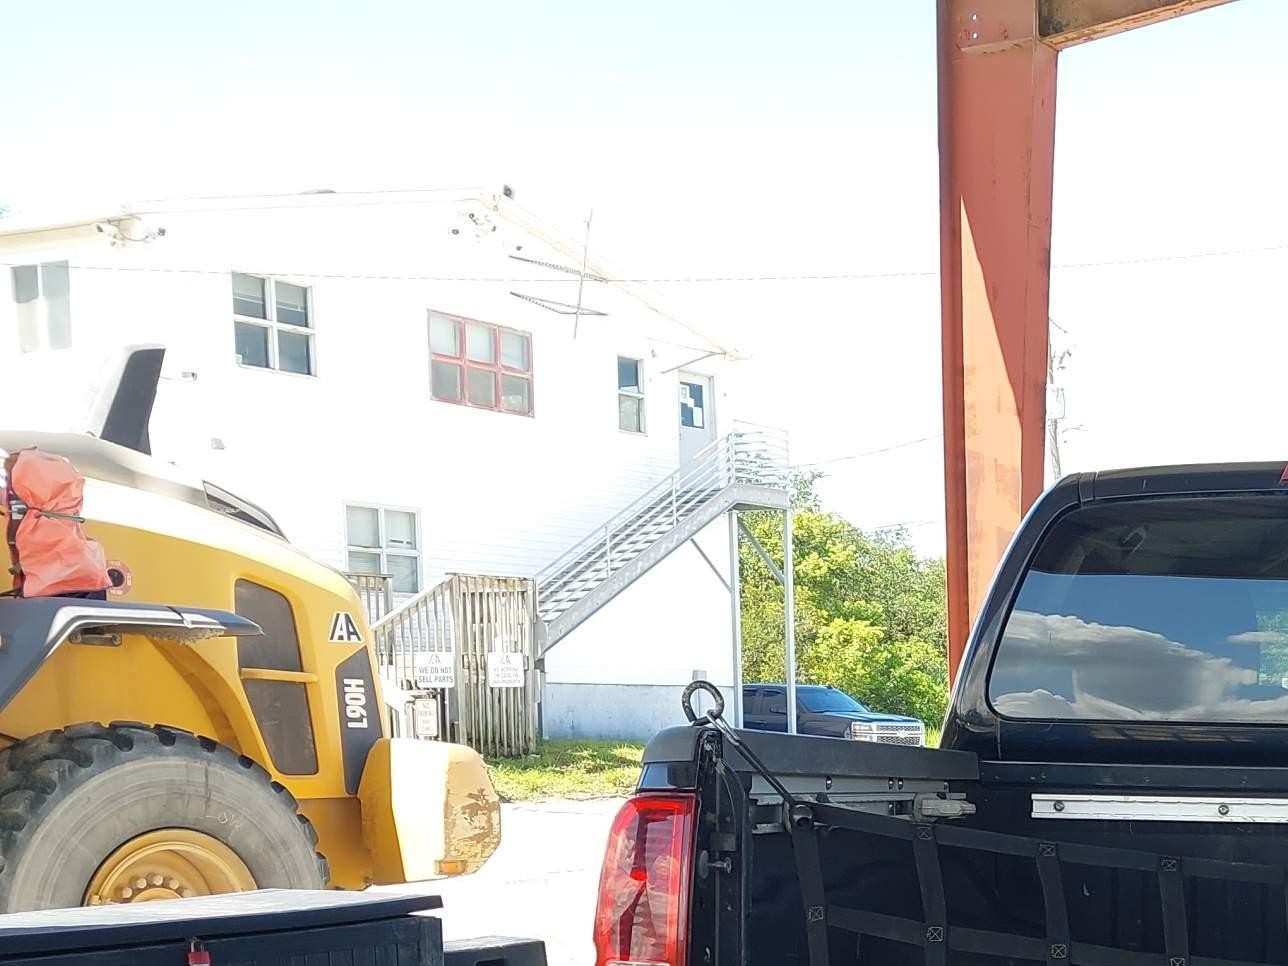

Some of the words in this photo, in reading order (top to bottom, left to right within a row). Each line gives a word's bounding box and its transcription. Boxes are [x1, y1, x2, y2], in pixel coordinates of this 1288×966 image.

[418, 666, 429, 674] WE
[430, 666, 439, 674] DO
[440, 666, 452, 674] NOT
[418, 675, 433, 683] SELL
[434, 675, 454, 683] PARTS
[343, 678, 368, 729] L90H
